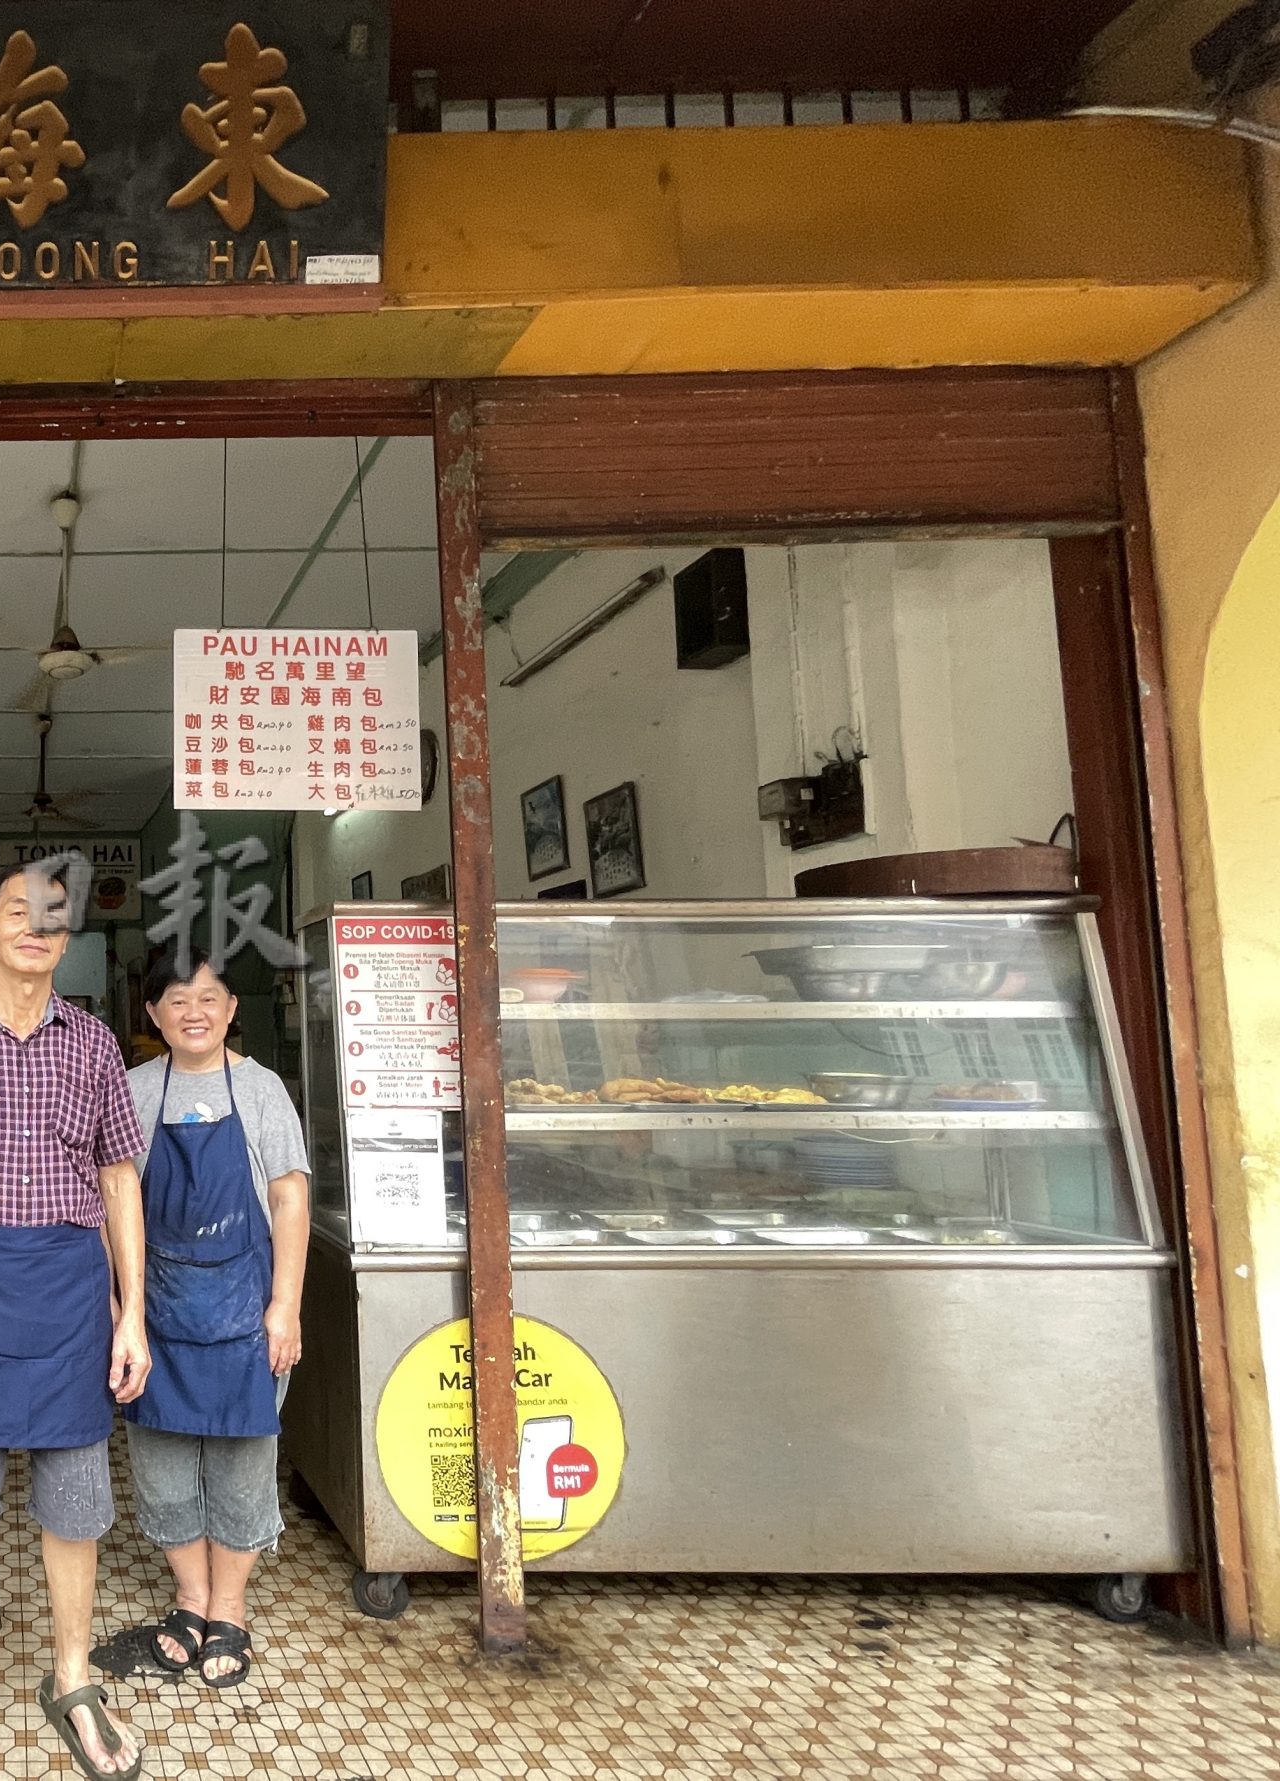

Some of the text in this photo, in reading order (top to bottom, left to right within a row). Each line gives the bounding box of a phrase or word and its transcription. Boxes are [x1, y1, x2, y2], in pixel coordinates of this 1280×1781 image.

[208, 239, 299, 280] HAI
[203, 635, 388, 657] PAU HAINAM
[224, 661, 366, 681] 馳名萬里望
[209, 685, 383, 707] 財安園海南包
[185, 713, 255, 731] 咖央包
[307, 714, 377, 732] 雞肉包
[185, 736, 255, 753] 豆沙包
[308, 738, 377, 755] 叉燒包
[185, 759, 255, 775] 蓮蓉包
[307, 761, 377, 778] 生肉包
[185, 781, 229, 797] 菜包
[308, 783, 352, 800] 大包
[92, 844, 133, 863] HAI
[341, 925, 455, 939] SOP COVID-19
[349, 966, 354, 978] 1
[350, 1003, 357, 1014] 2
[516, 1371, 553, 1389] Car
[552, 1463, 590, 1473] Bermula
[554, 1475, 582, 1490] RM1
